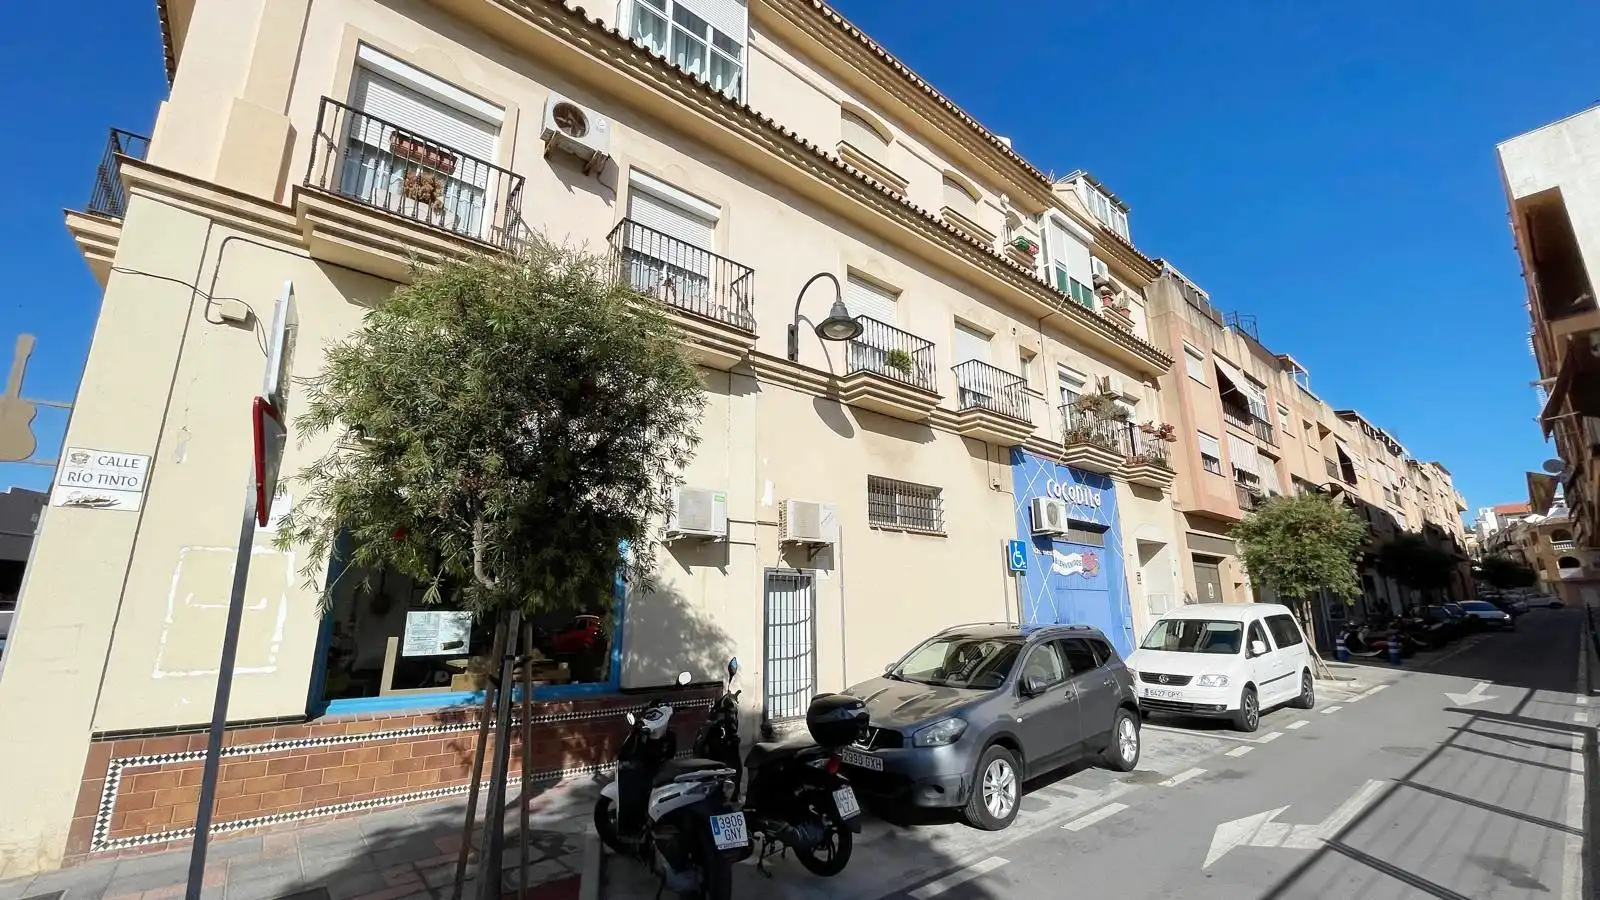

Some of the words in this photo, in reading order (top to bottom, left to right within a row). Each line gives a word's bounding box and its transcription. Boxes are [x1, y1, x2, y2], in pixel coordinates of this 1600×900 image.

[97, 455, 140, 468] CALLE
[67, 469, 93, 483] RÍO
[98, 473, 138, 487] TINTO
[719, 814, 743, 829] 3906
[724, 827, 742, 840] GNY
